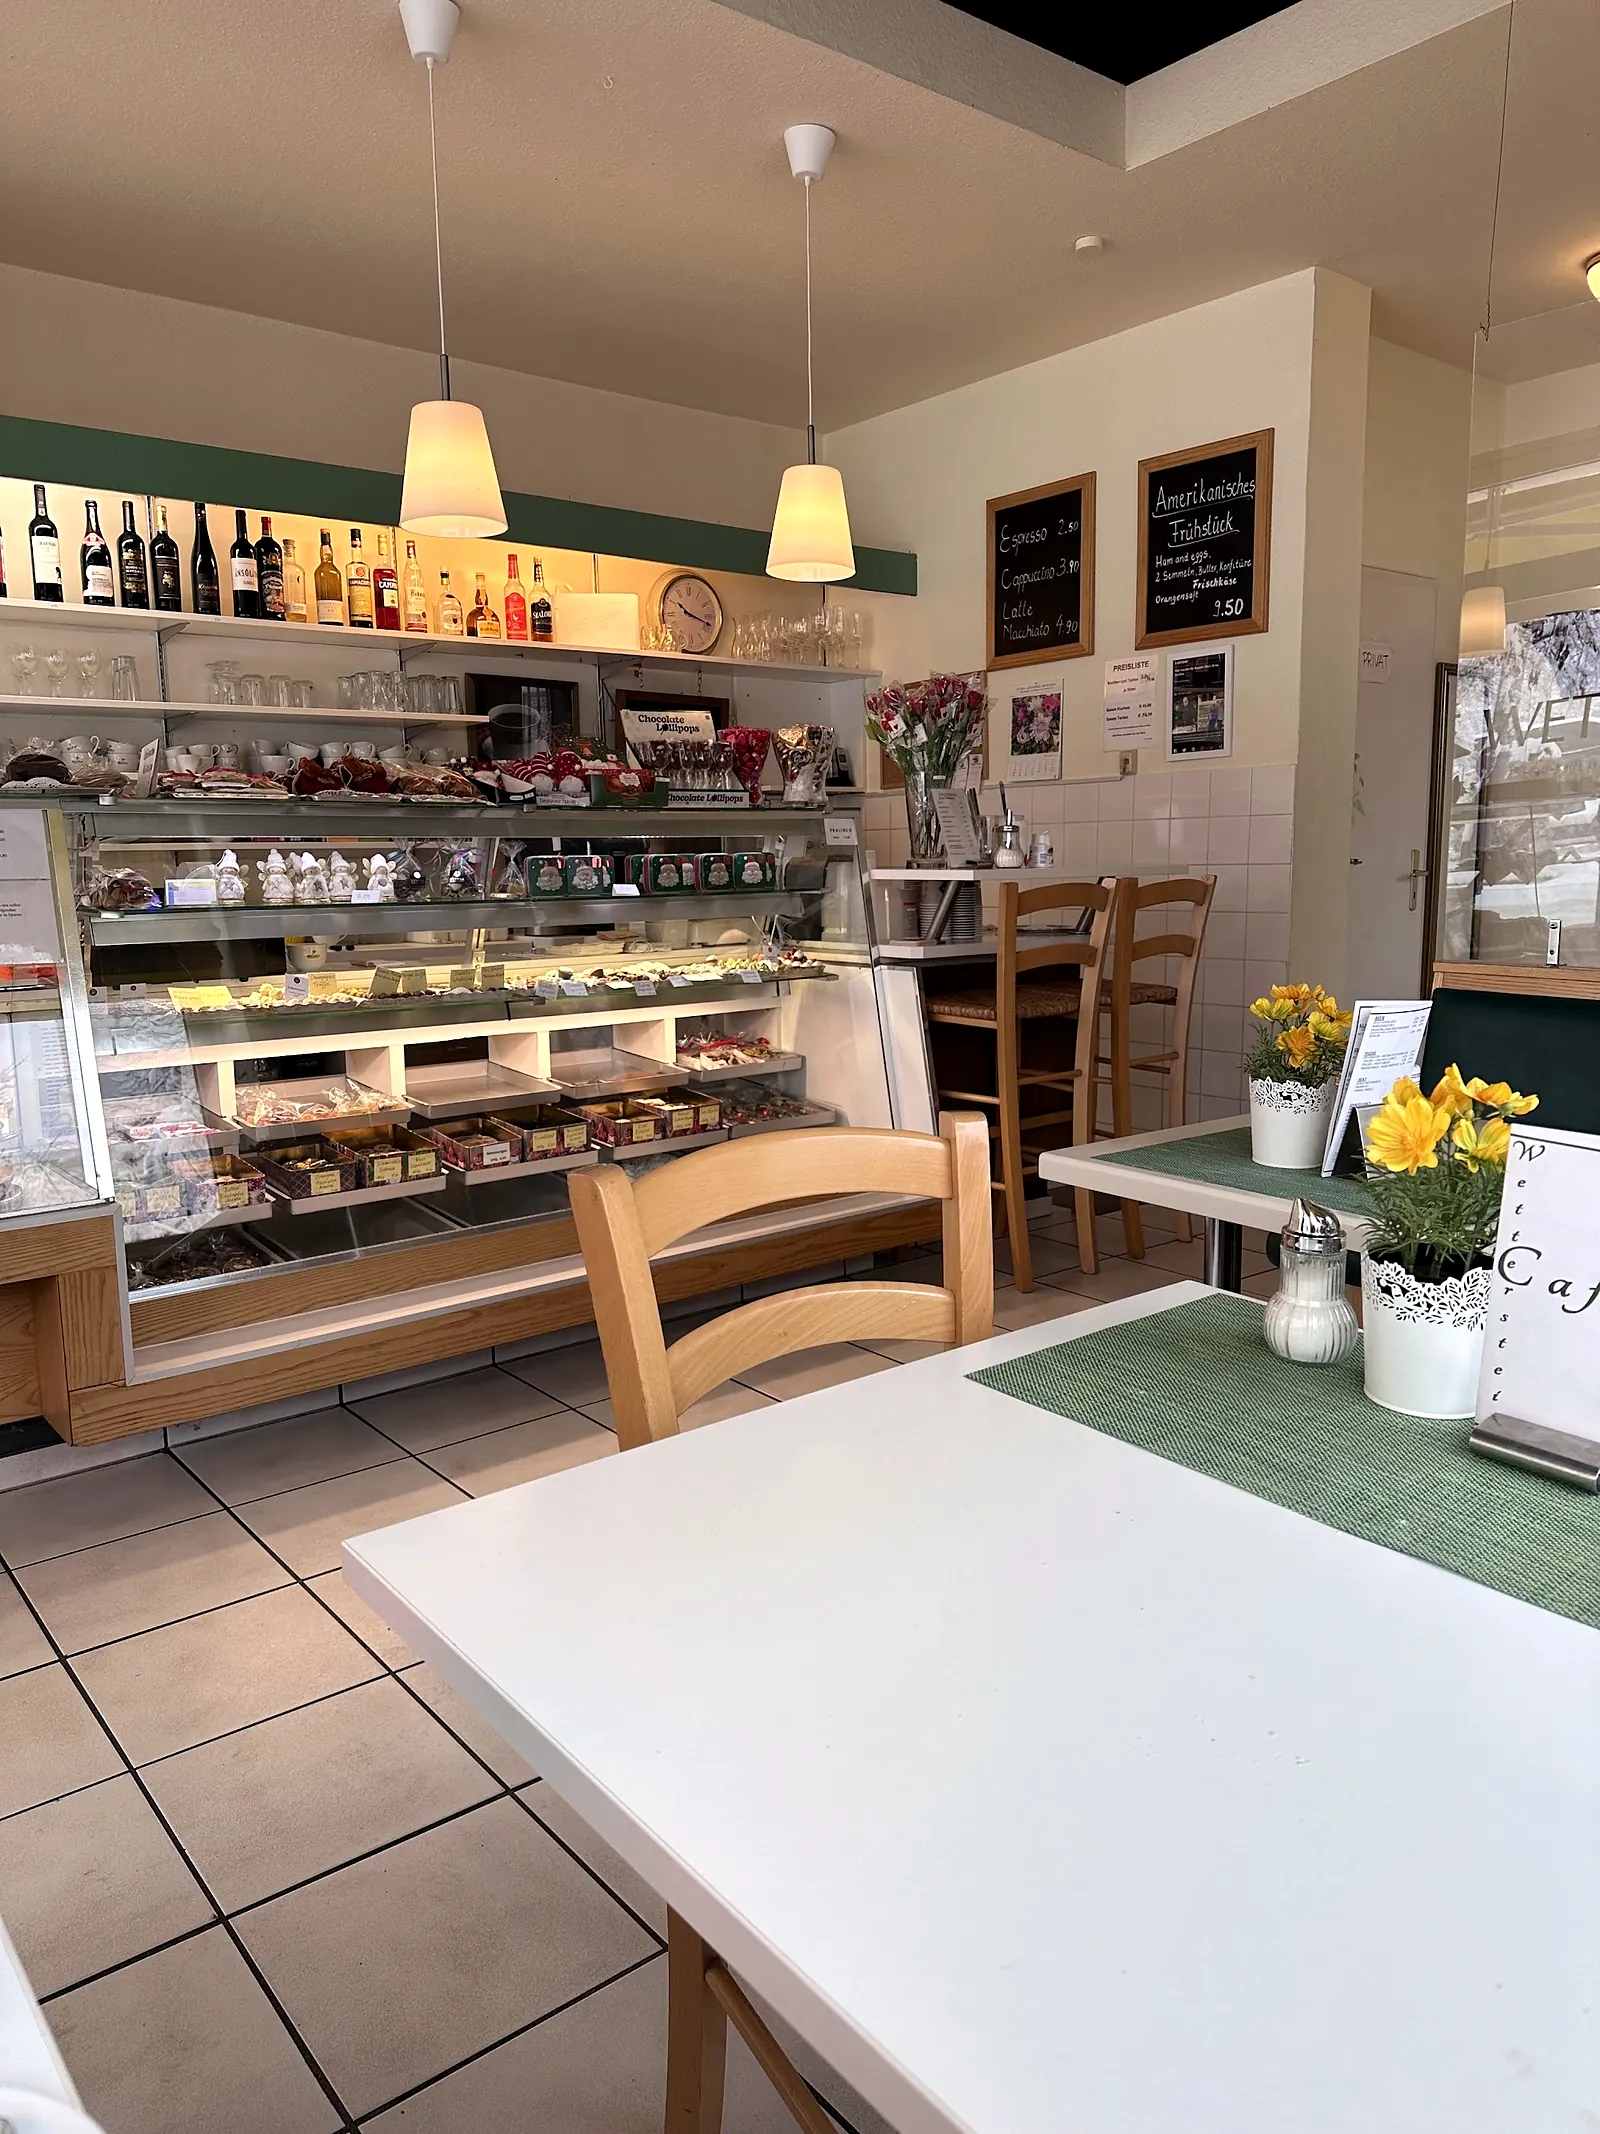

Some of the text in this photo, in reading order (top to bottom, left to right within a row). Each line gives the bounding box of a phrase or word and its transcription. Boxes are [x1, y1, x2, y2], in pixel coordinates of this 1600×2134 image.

[1156, 472, 1256, 512] Amerikanisches
[1169, 510, 1234, 543] Frühstück
[1000, 519, 1079, 556] Espresso 2.50
[1155, 555, 1174, 568] Ham
[1175, 552, 1189, 563] and
[1001, 558, 1080, 593] Cappuccino 3.90
[1155, 572, 1160, 582] 2
[1192, 576, 1238, 589] Frischkäse
[1155, 590, 1199, 605] Orangensaft
[1003, 600, 1034, 619] Latte
[1213, 598, 1244, 617] 9.50
[1056, 614, 1078, 635] 4.90
[1113, 660, 1149, 672] PREISLISTE
[1362, 651, 1389, 671] PRIVAT
[638, 714, 685, 724] Chocolate
[656, 723, 700, 735] Lollipops
[706, 793, 744, 805] Lollipops
